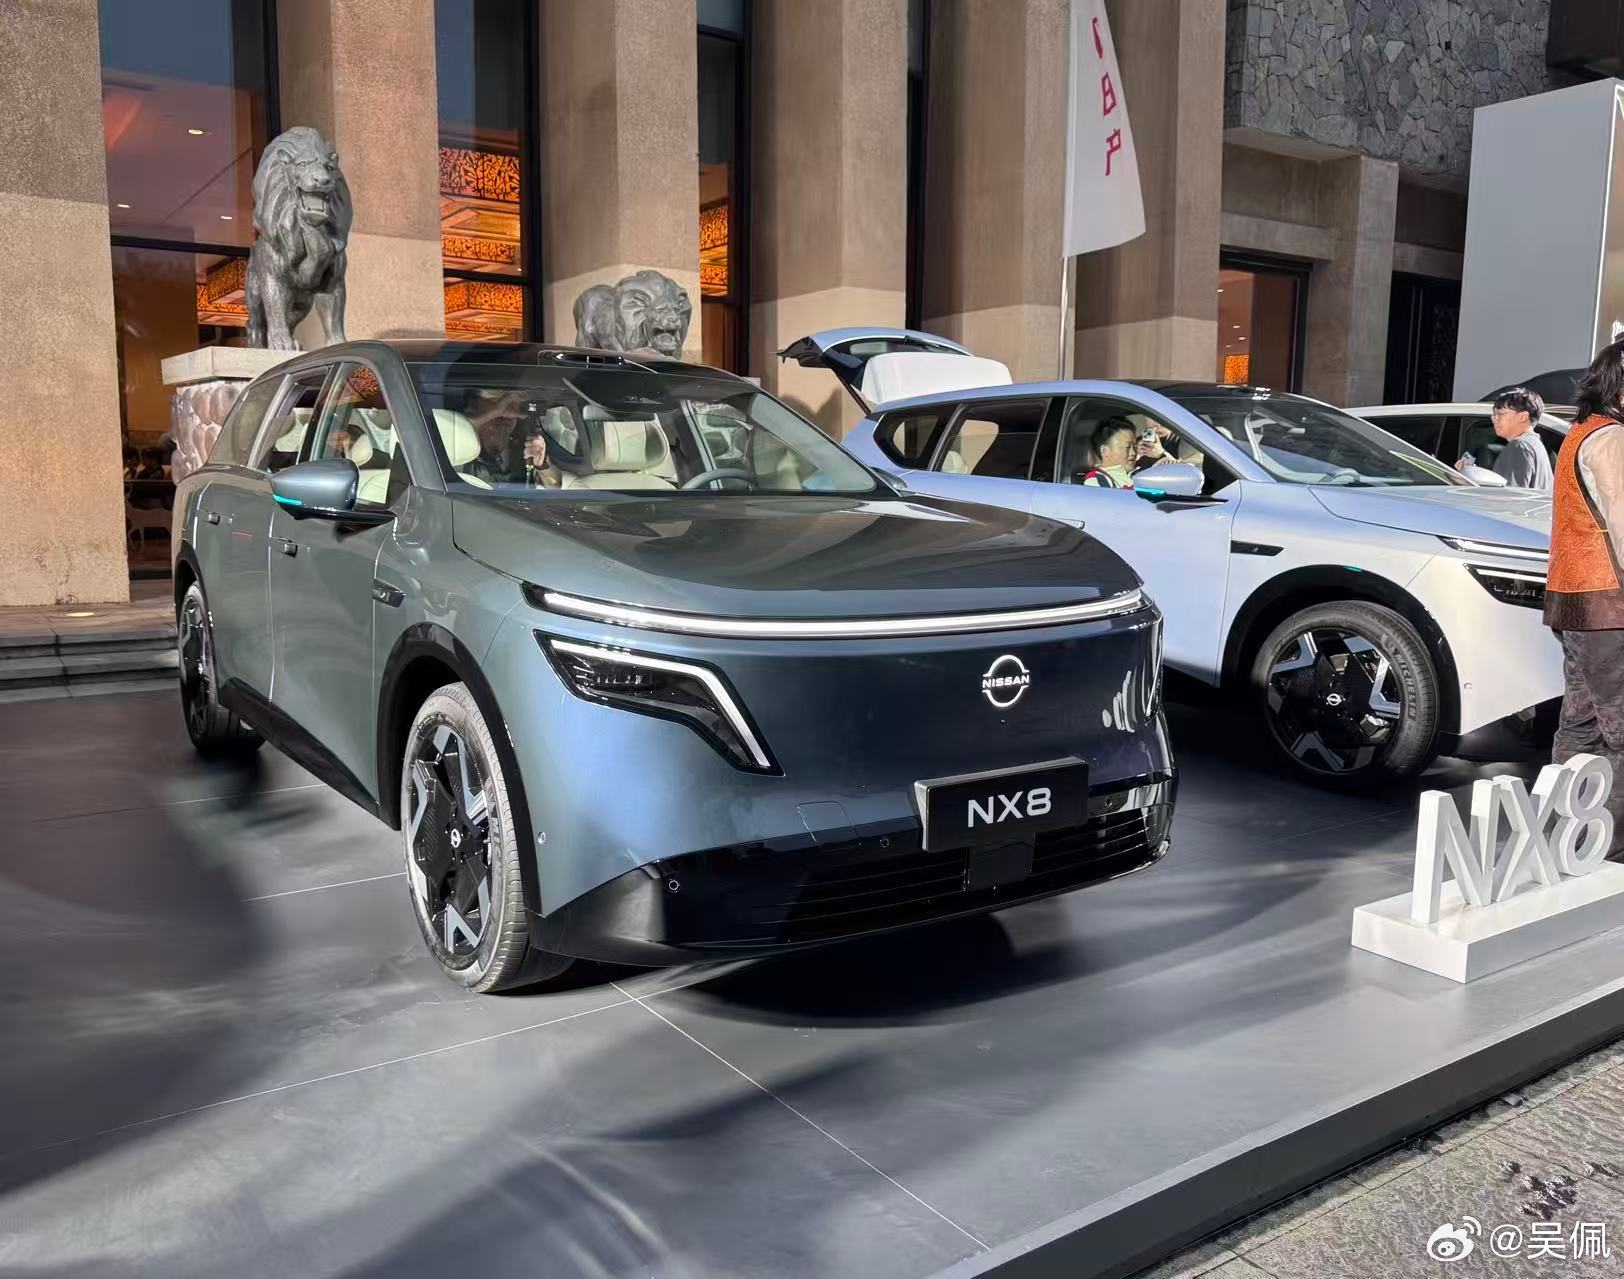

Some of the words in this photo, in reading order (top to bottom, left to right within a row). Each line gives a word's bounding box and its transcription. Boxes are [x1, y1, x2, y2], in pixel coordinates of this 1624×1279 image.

[982, 674, 1030, 689] NISSAN
[1395, 652, 1417, 719] MICHELIN
[967, 787, 1052, 828] NX8
[1411, 753, 1614, 923] NX8
